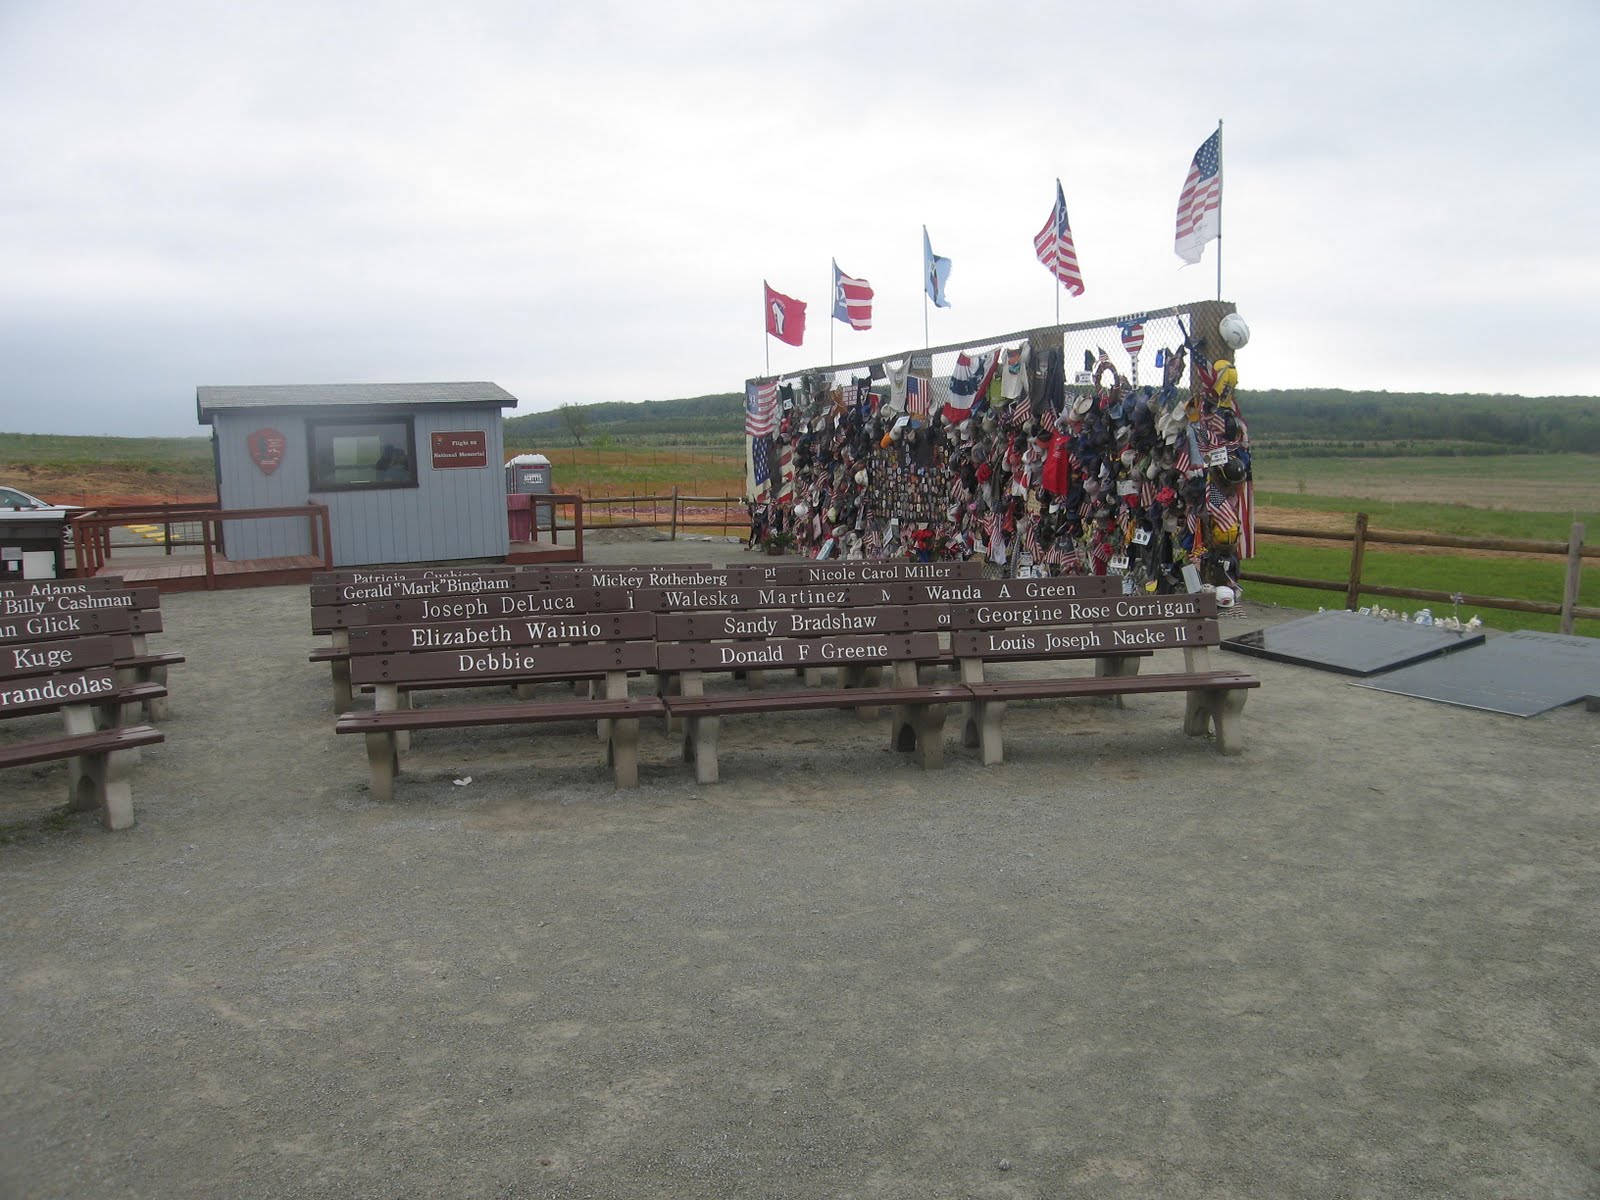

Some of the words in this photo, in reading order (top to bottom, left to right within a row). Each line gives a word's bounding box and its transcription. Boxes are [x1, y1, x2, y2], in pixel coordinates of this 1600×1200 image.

[592, 574, 644, 589] Mickey
[649, 573, 728, 587] Rothenberg
[809, 568, 856, 581] Nicole
[861, 567, 899, 579] Carol
[904, 566, 951, 578] Miller
[343, 583, 393, 600] Gerald
[447, 577, 510, 594] Bingham
[665, 589, 740, 607] Waleska
[758, 588, 846, 605] Martinez
[925, 585, 982, 600] Wanda
[998, 584, 1011, 598] A
[1025, 582, 1077, 597] Green
[57, 595, 132, 610] Cashman
[422, 599, 489, 619] Joseph
[501, 594, 576, 615] DeLuca
[977, 605, 1062, 626] Georgine
[1068, 603, 1111, 620] Rose
[1115, 600, 1196, 618] Corrigan
[27, 615, 81, 635] Glick
[411, 626, 512, 647] Elizabeth
[525, 620, 601, 641] Wainio
[723, 616, 778, 636] Sandy
[790, 613, 878, 632] Bradshaw
[989, 633, 1036, 651] Louis
[1044, 630, 1101, 652] Joseph
[1112, 627, 1166, 646] Nacke
[1174, 626, 1188, 642] II
[12, 648, 73, 669] Kuge
[458, 654, 536, 672] Debbie
[720, 645, 784, 665] Donald
[798, 643, 811, 661] F
[820, 641, 889, 660] Greene
